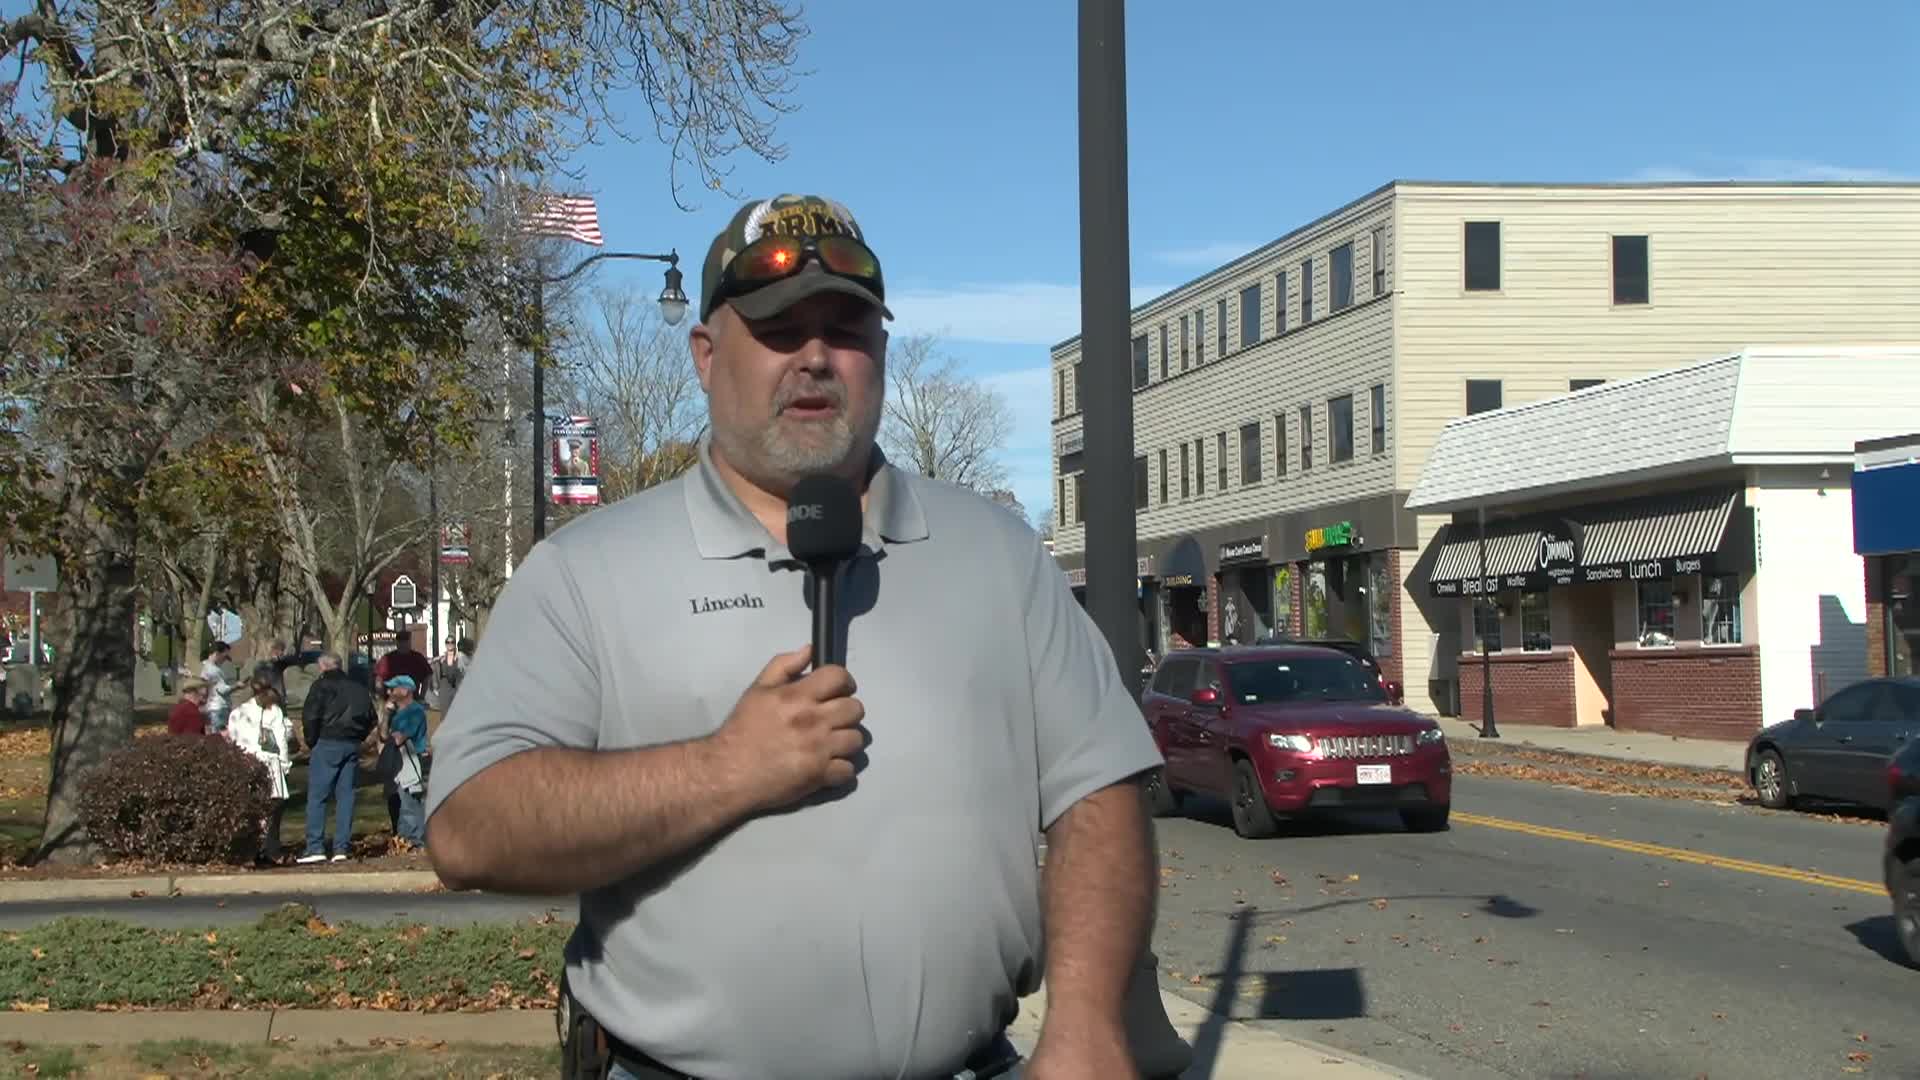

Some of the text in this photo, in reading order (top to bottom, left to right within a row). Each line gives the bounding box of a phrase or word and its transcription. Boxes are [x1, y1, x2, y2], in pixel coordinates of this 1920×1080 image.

[1304, 521, 1351, 553] SUBWAY
[1586, 559, 1701, 581] Sandwiches Lunch Burgers
[1462, 577, 1499, 595] Breaast
[1506, 575, 1527, 588] Waffles
[689, 593, 765, 615] Lincoln
